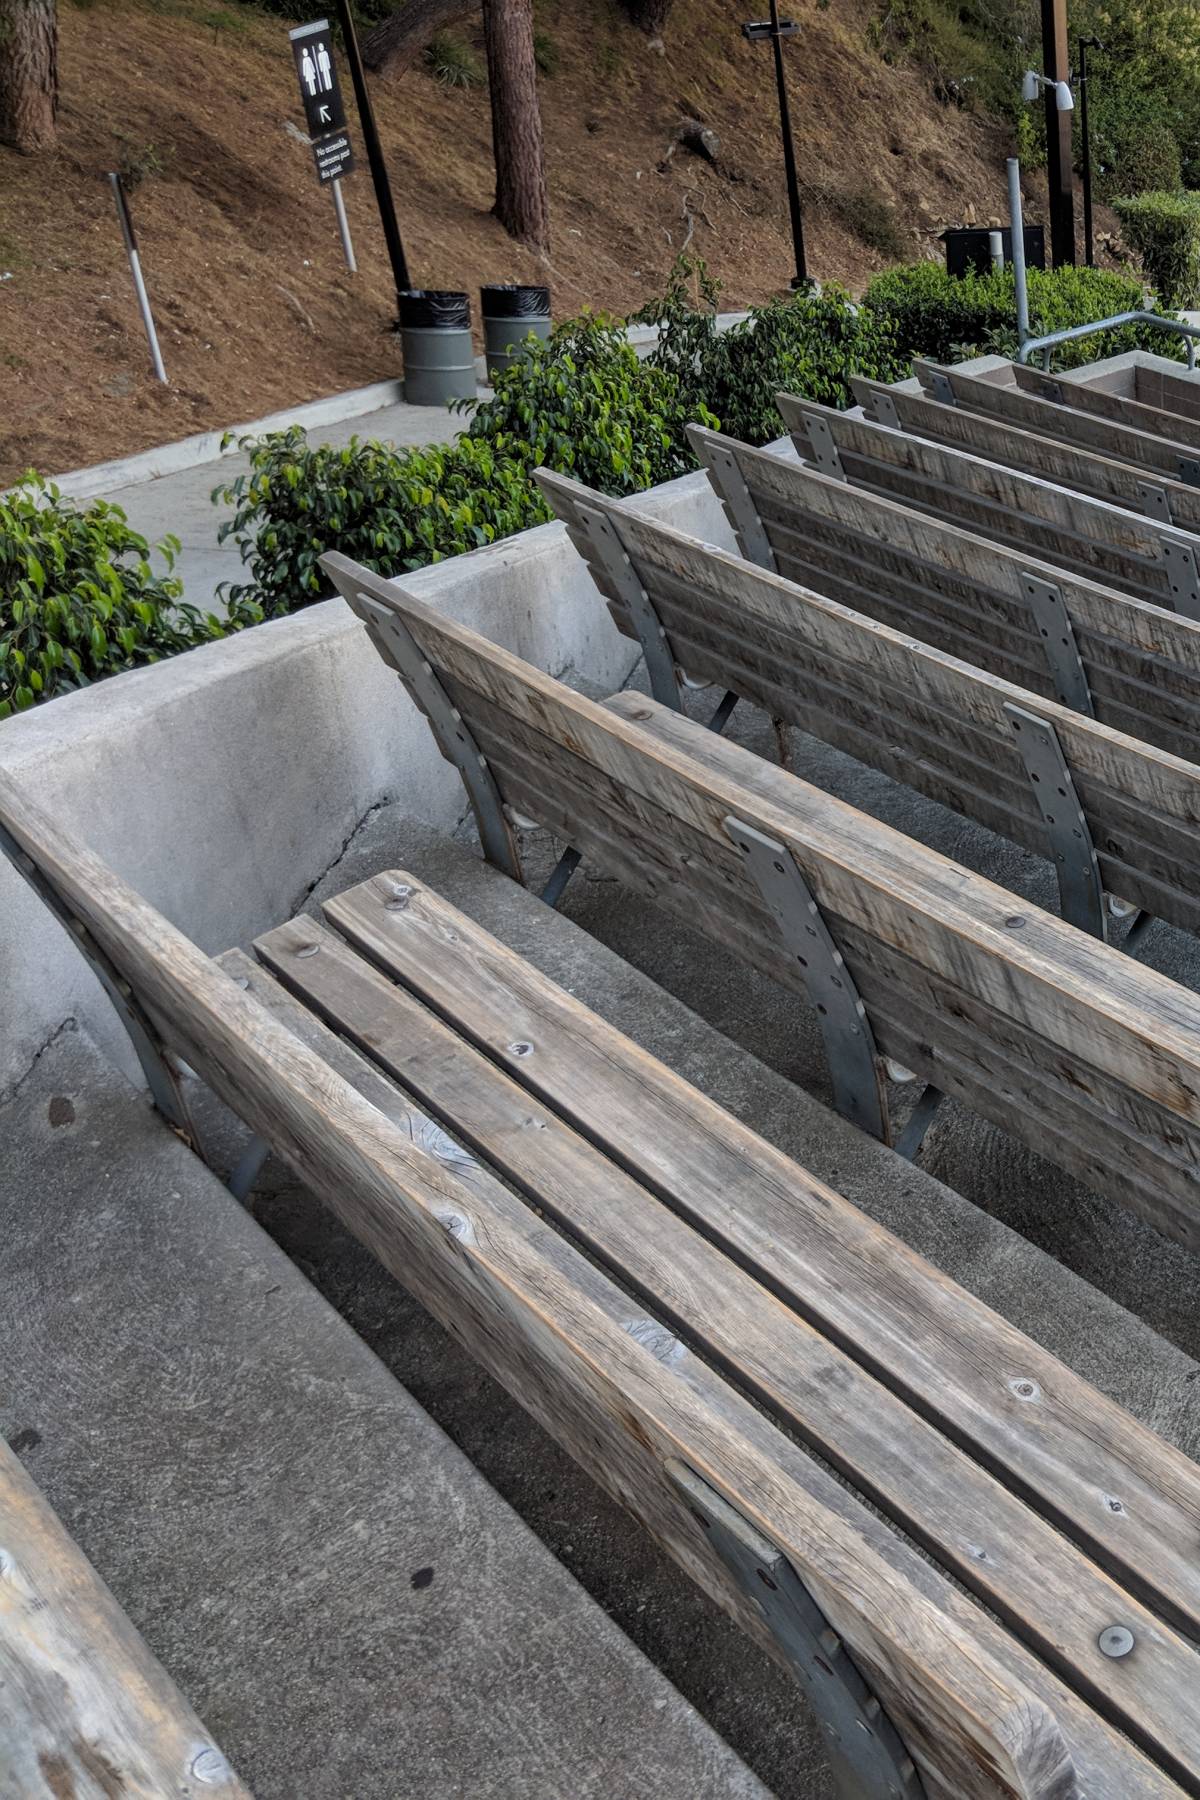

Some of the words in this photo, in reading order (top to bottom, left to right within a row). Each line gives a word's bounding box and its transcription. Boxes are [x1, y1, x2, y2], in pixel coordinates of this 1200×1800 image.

[316, 148, 325, 157] No
[325, 138, 347, 153] accessible
[319, 155, 340, 167] restrooms
[340, 149, 350, 161] past
